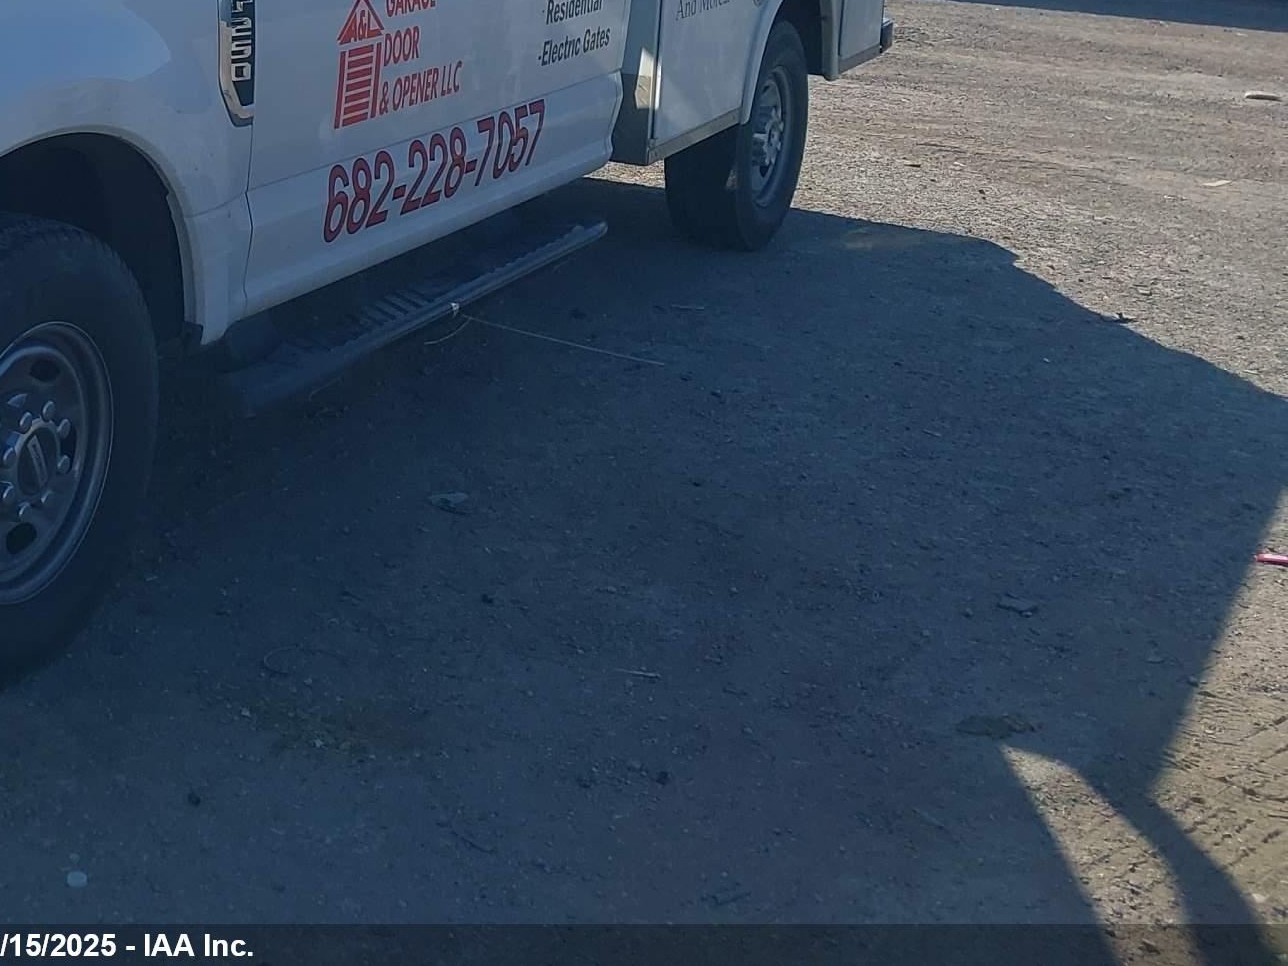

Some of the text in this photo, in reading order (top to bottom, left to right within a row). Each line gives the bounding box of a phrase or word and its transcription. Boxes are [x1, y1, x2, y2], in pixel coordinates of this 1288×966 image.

[383, 26, 420, 67] DOOR
[582, 26, 611, 54] Gates
[378, 60, 463, 114] & OPENER LLC
[323, 98, 546, 244] 682-228-7057
